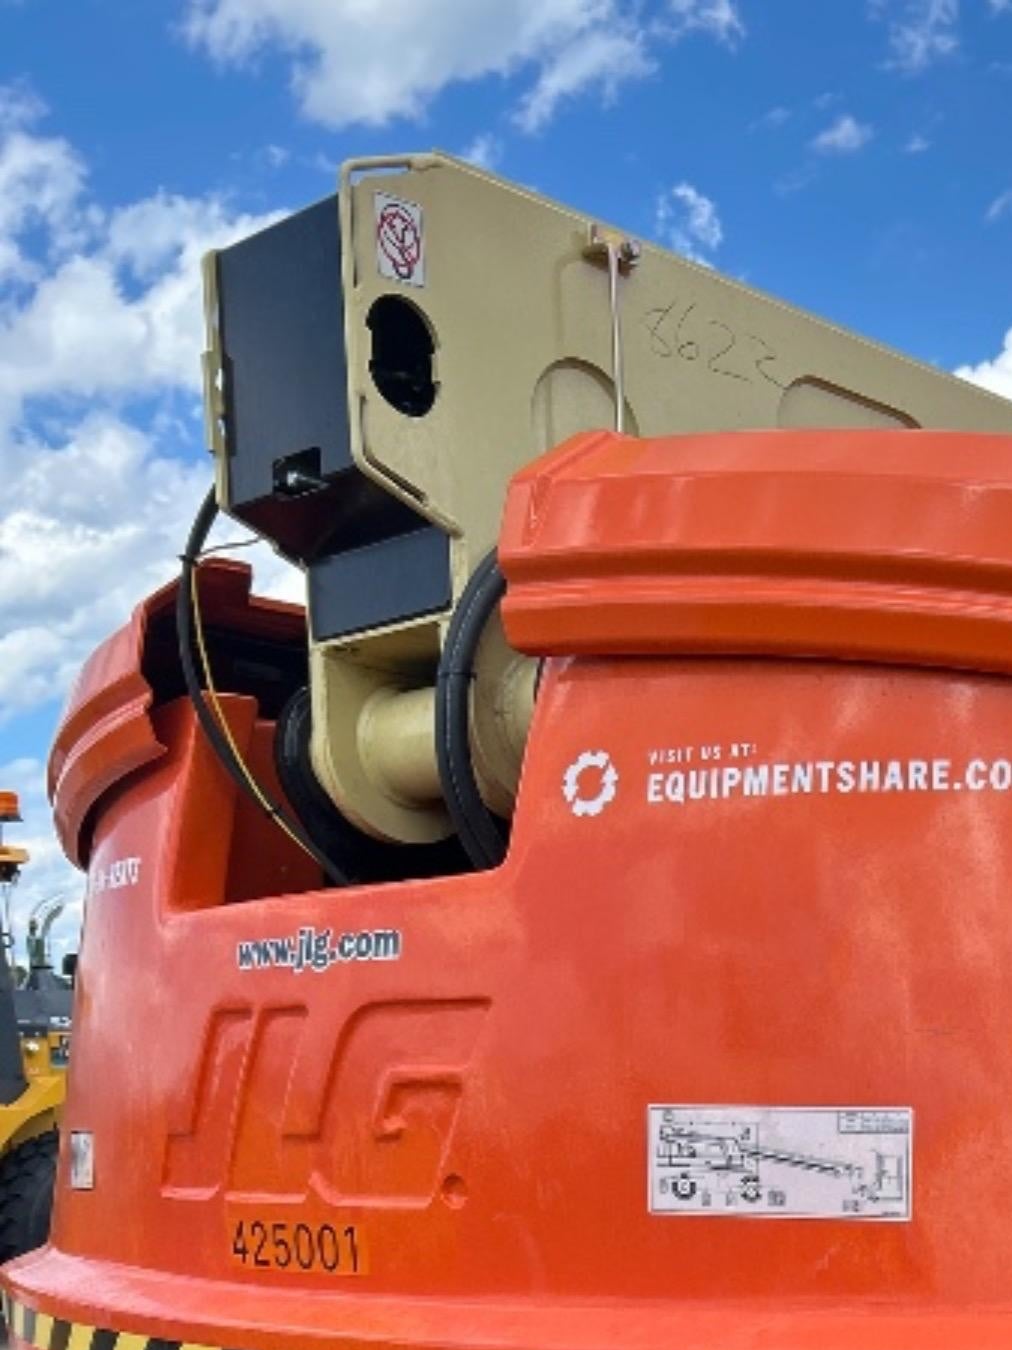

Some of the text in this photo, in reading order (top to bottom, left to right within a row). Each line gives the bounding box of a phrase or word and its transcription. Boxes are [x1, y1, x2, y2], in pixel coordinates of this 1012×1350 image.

[648, 747, 693, 765] VISIT
[701, 745, 721, 760] US
[237, 926, 401, 973] www.jlg.com
[232, 1221, 360, 1273] 425001
